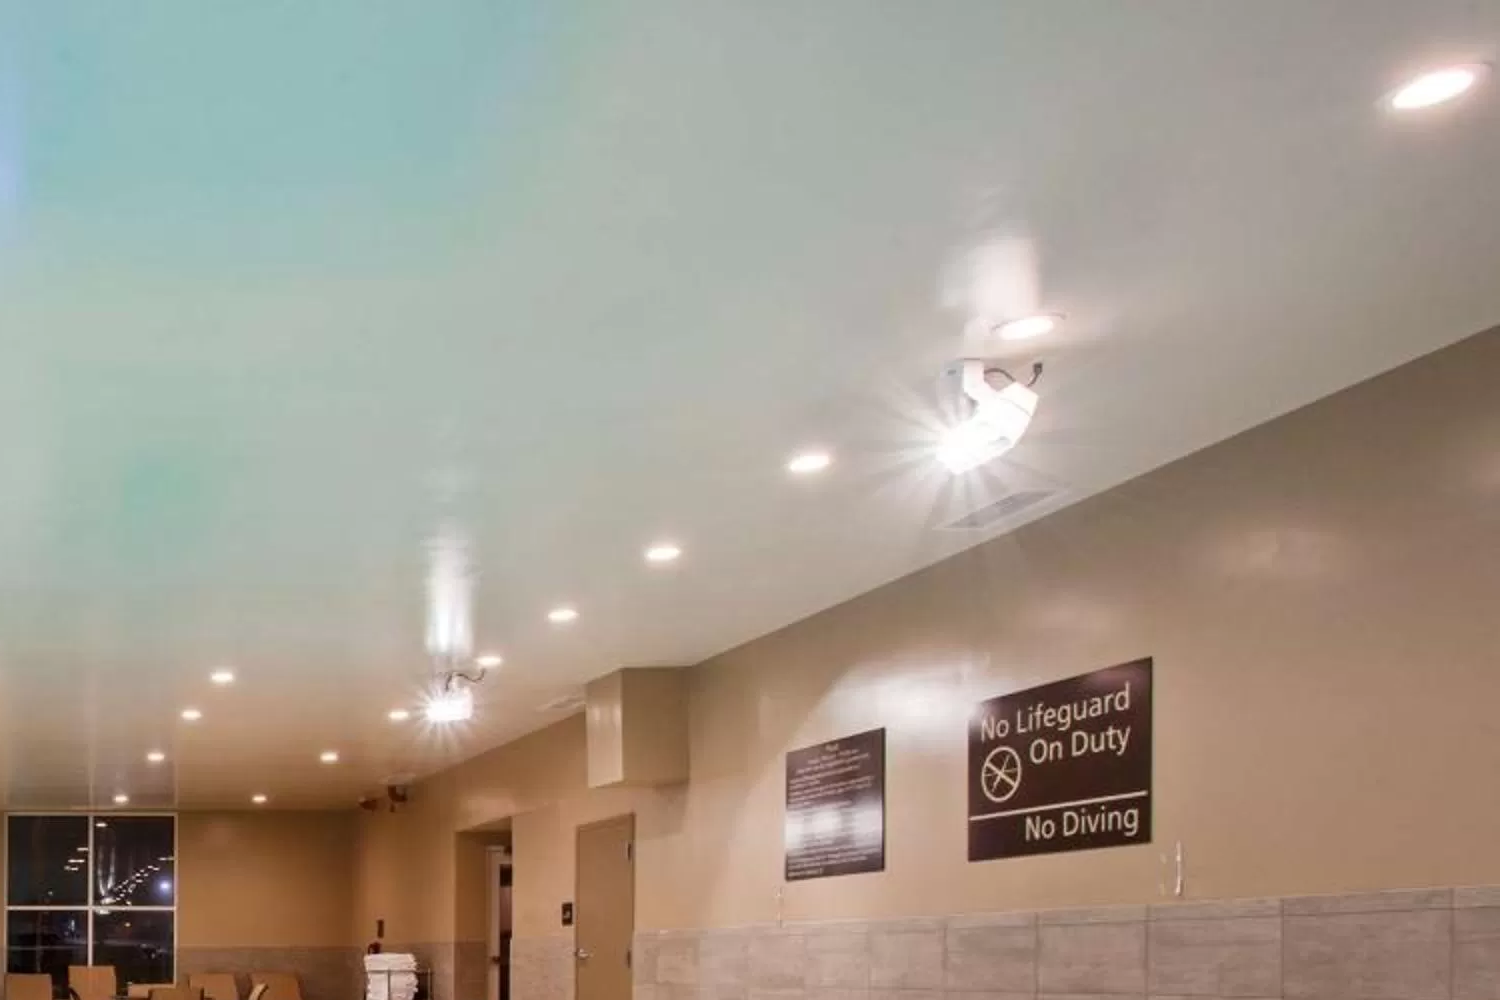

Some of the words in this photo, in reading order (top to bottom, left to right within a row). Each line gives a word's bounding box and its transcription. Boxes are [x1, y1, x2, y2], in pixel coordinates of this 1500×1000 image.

[981, 715, 1009, 742] No
[1016, 681, 1130, 733] Lifeguard
[1029, 738, 1063, 764] On
[1071, 725, 1131, 756] Duty
[1025, 815, 1055, 840] No
[1063, 805, 1139, 837] Diving
